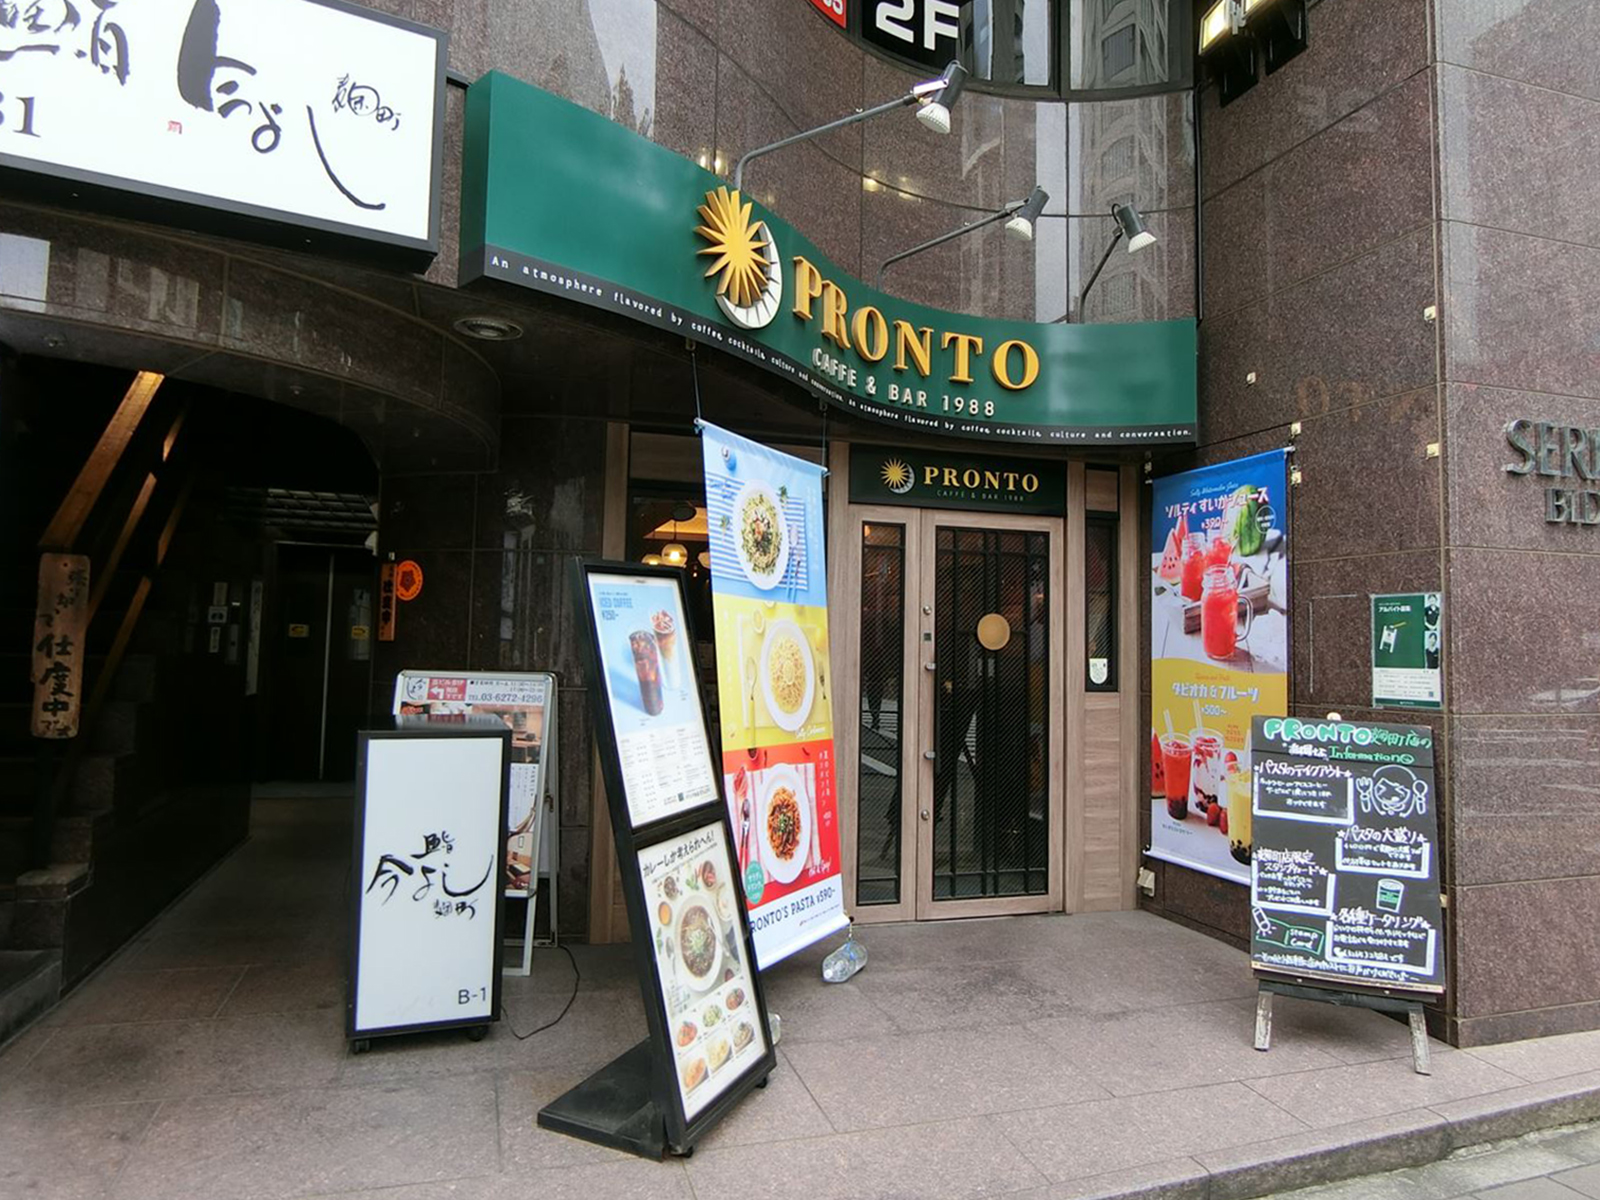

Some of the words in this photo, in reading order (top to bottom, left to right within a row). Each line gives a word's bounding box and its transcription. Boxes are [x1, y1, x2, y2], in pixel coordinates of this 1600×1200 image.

[876, 0, 960, 50] 2F
[793, 255, 1040, 390] PRONTO
[491, 255, 509, 270] An
[522, 265, 602, 297] atmosphere
[614, 291, 662, 318] flavored
[671, 313, 683, 327] by
[798, 370, 809, 382] and
[859, 402, 899, 420] atmosphere
[904, 412, 938, 428] flavored
[944, 421, 955, 431] by
[1049, 429, 1087, 440] culture
[1095, 430, 1112, 440] and
[866, 375, 877, 395] &
[888, 384, 928, 408] BAR
[942, 395, 995, 417] 1988
[923, 466, 1039, 493] PRONTO
[748, 906, 789, 934] RONTO'S
[790, 895, 815, 915] PASTA
[458, 987, 487, 1005] B-1
